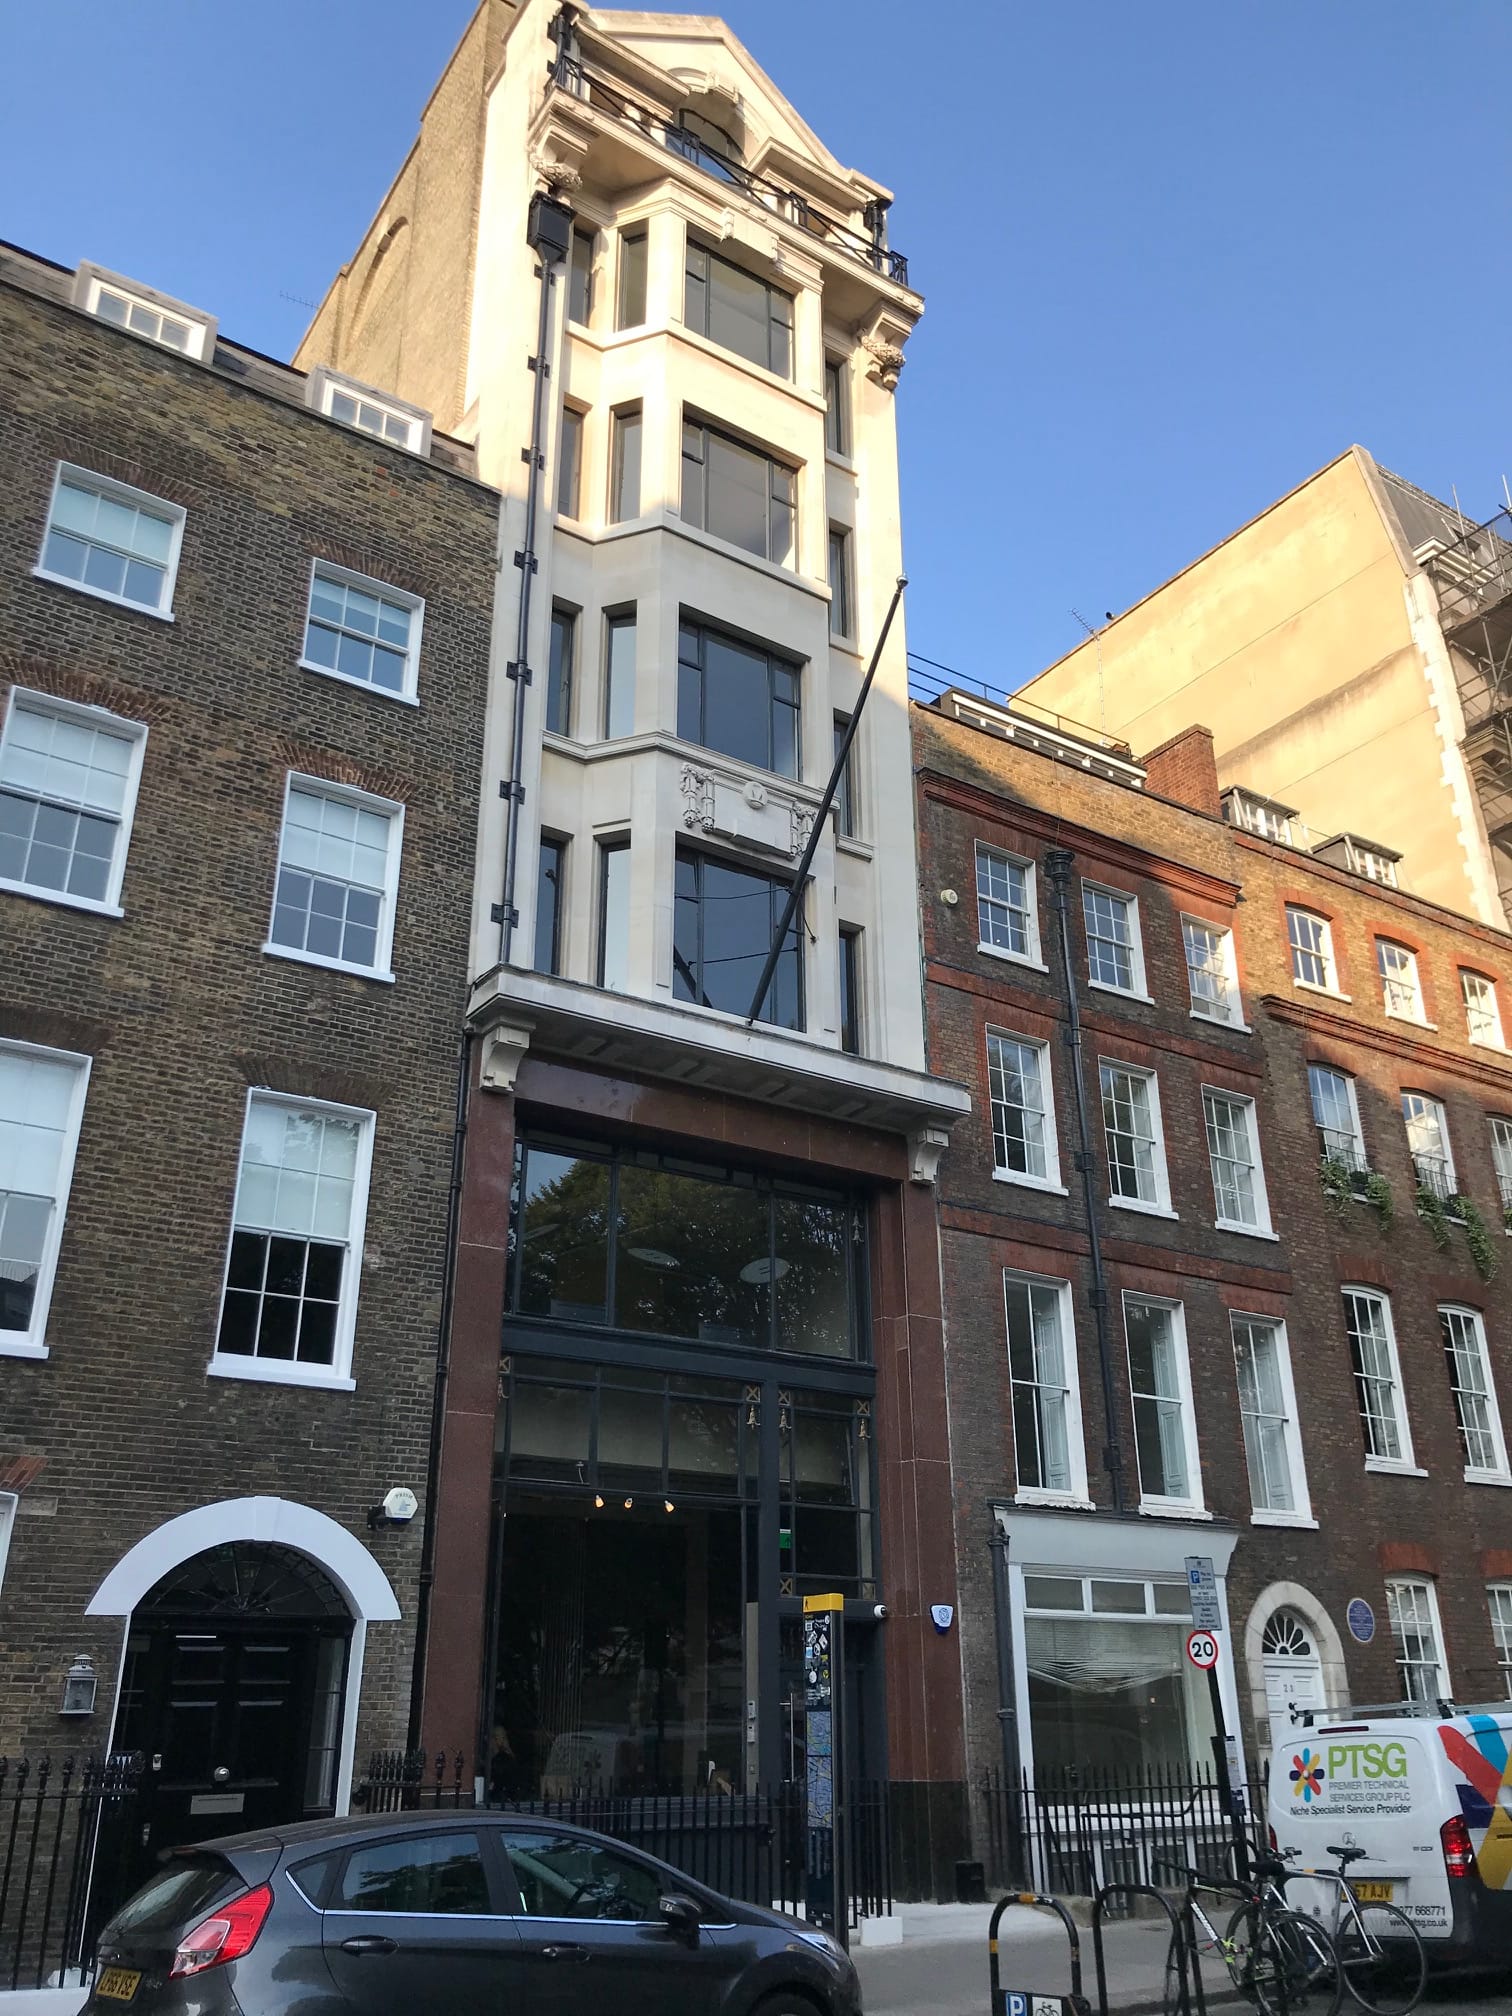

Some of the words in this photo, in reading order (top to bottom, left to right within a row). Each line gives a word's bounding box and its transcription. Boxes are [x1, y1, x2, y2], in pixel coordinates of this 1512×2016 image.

[1192, 1641, 1214, 1657] 20
[1328, 1743, 1407, 1779] PTSG
[1329, 1781, 1361, 1790] PREMIER
[1364, 1780, 1409, 1789] TECHNICAL
[1330, 1793, 1364, 1802] SERVICES
[1365, 1793, 1393, 1802] GROUP
[1394, 1792, 1411, 1801] PLC
[1290, 1806, 1309, 1816] Niche
[1311, 1805, 1345, 1816] Specialist
[1347, 1804, 1375, 1814] Service
[1377, 1803, 1412, 1814] Provider
[1415, 1905, 1446, 1916] 668771
